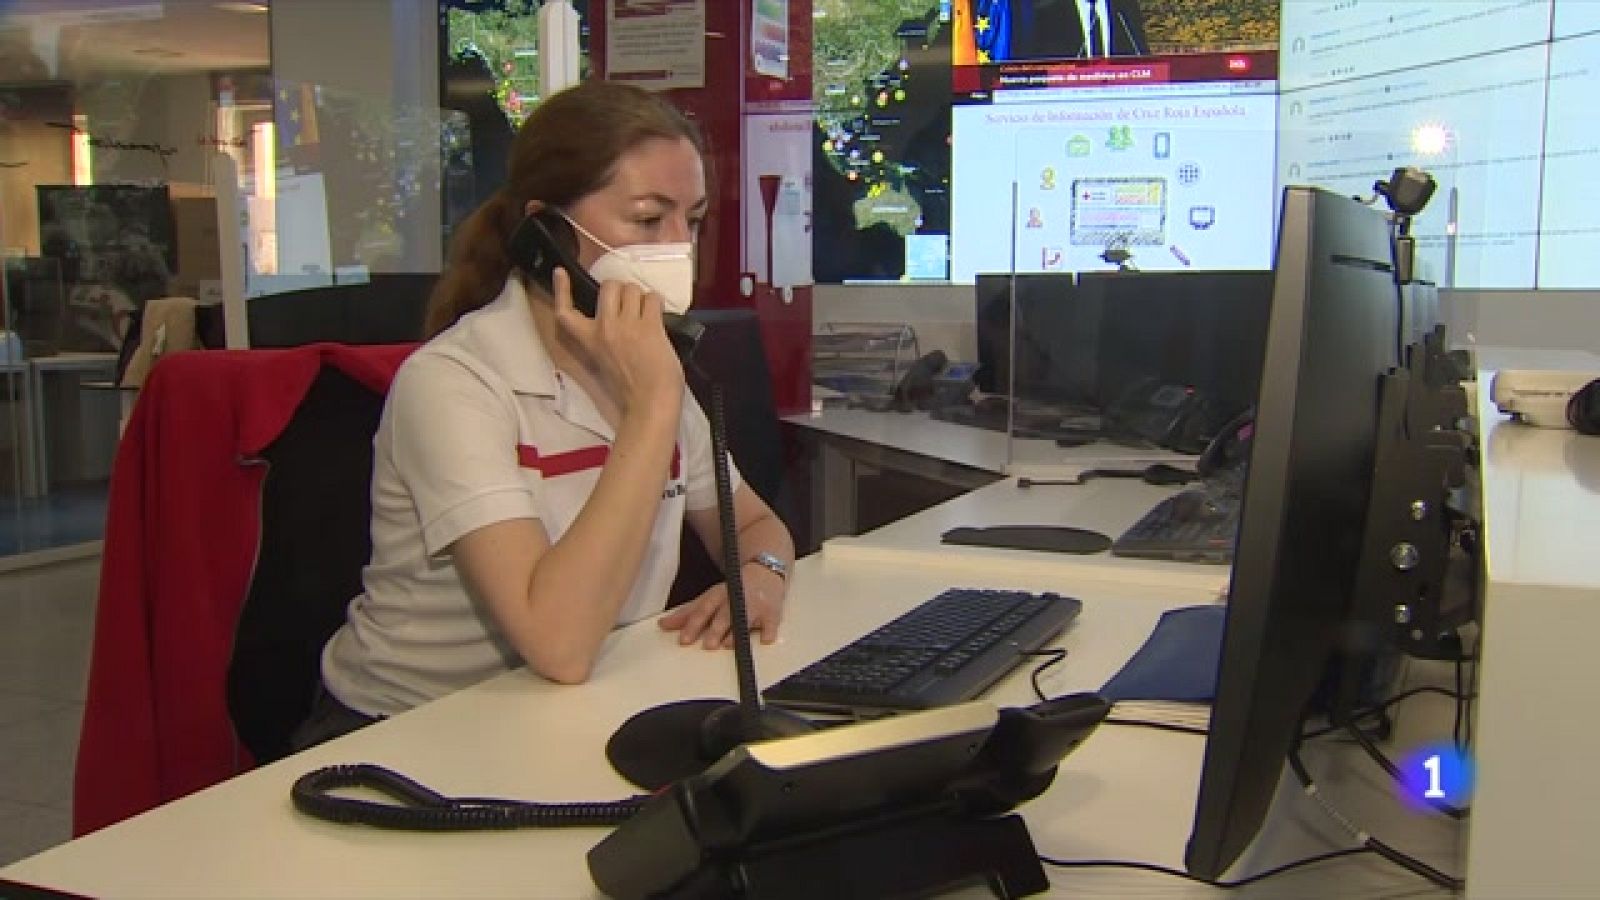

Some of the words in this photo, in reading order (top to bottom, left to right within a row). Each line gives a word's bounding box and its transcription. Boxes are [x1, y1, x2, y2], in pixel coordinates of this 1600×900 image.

[985, 113, 1029, 124] Servicio
[1034, 110, 1046, 122] de
[1118, 107, 1131, 120] de
[1132, 107, 1161, 120] Cruz
[1165, 106, 1191, 120] Roja
